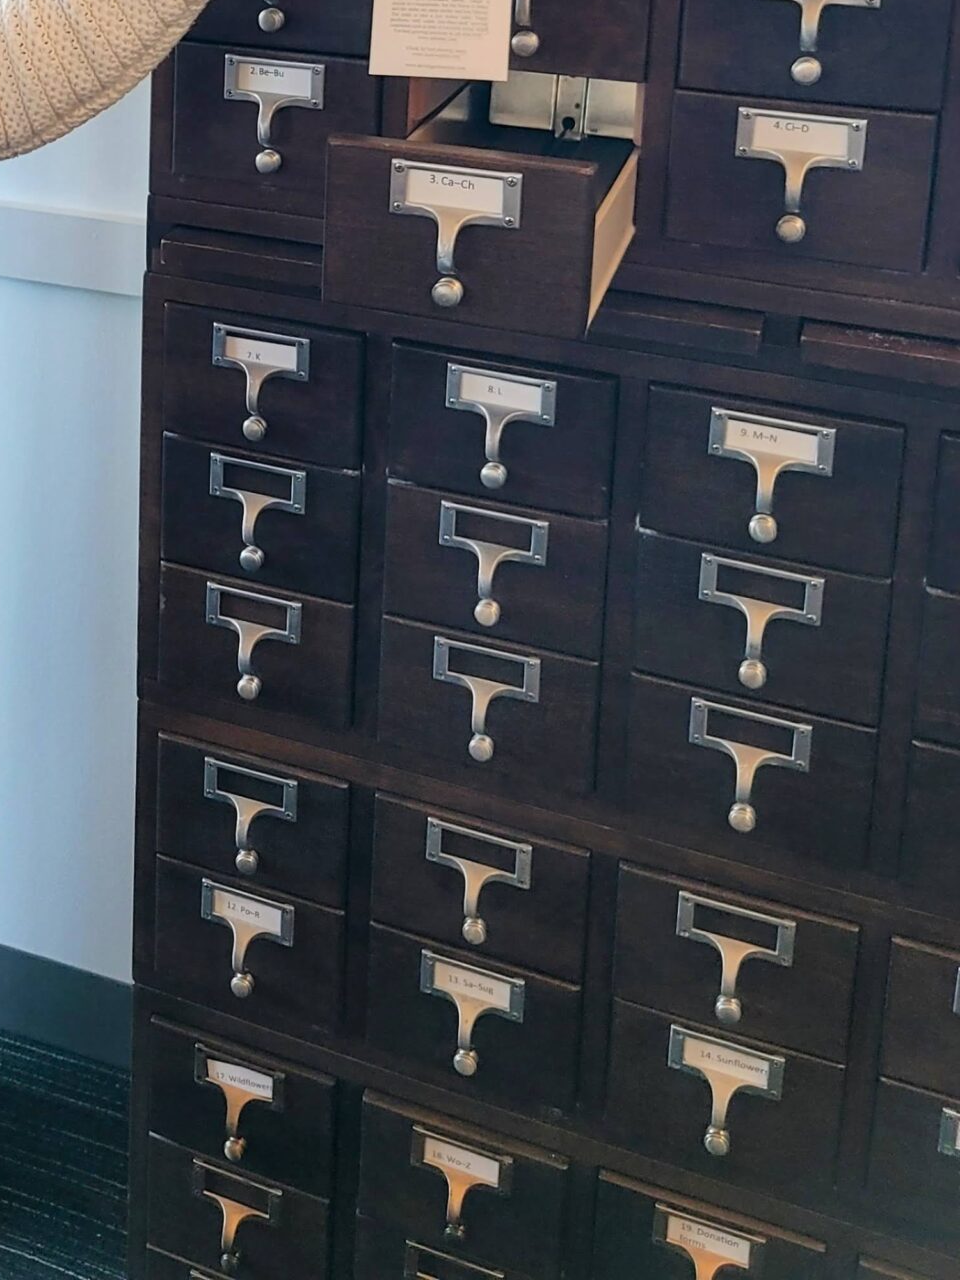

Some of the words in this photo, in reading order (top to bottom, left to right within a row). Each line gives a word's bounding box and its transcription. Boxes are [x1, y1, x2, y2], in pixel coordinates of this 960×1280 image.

[250, 67, 258, 76] 2.
[259, 67, 285, 78] Be-Bu
[773, 121, 783, 130] 4.
[429, 174, 439, 185] 3.
[441, 176, 475, 190] Ca-Ch
[752, 430, 778, 444] M-N
[696, 1227, 739, 1249] Donation
